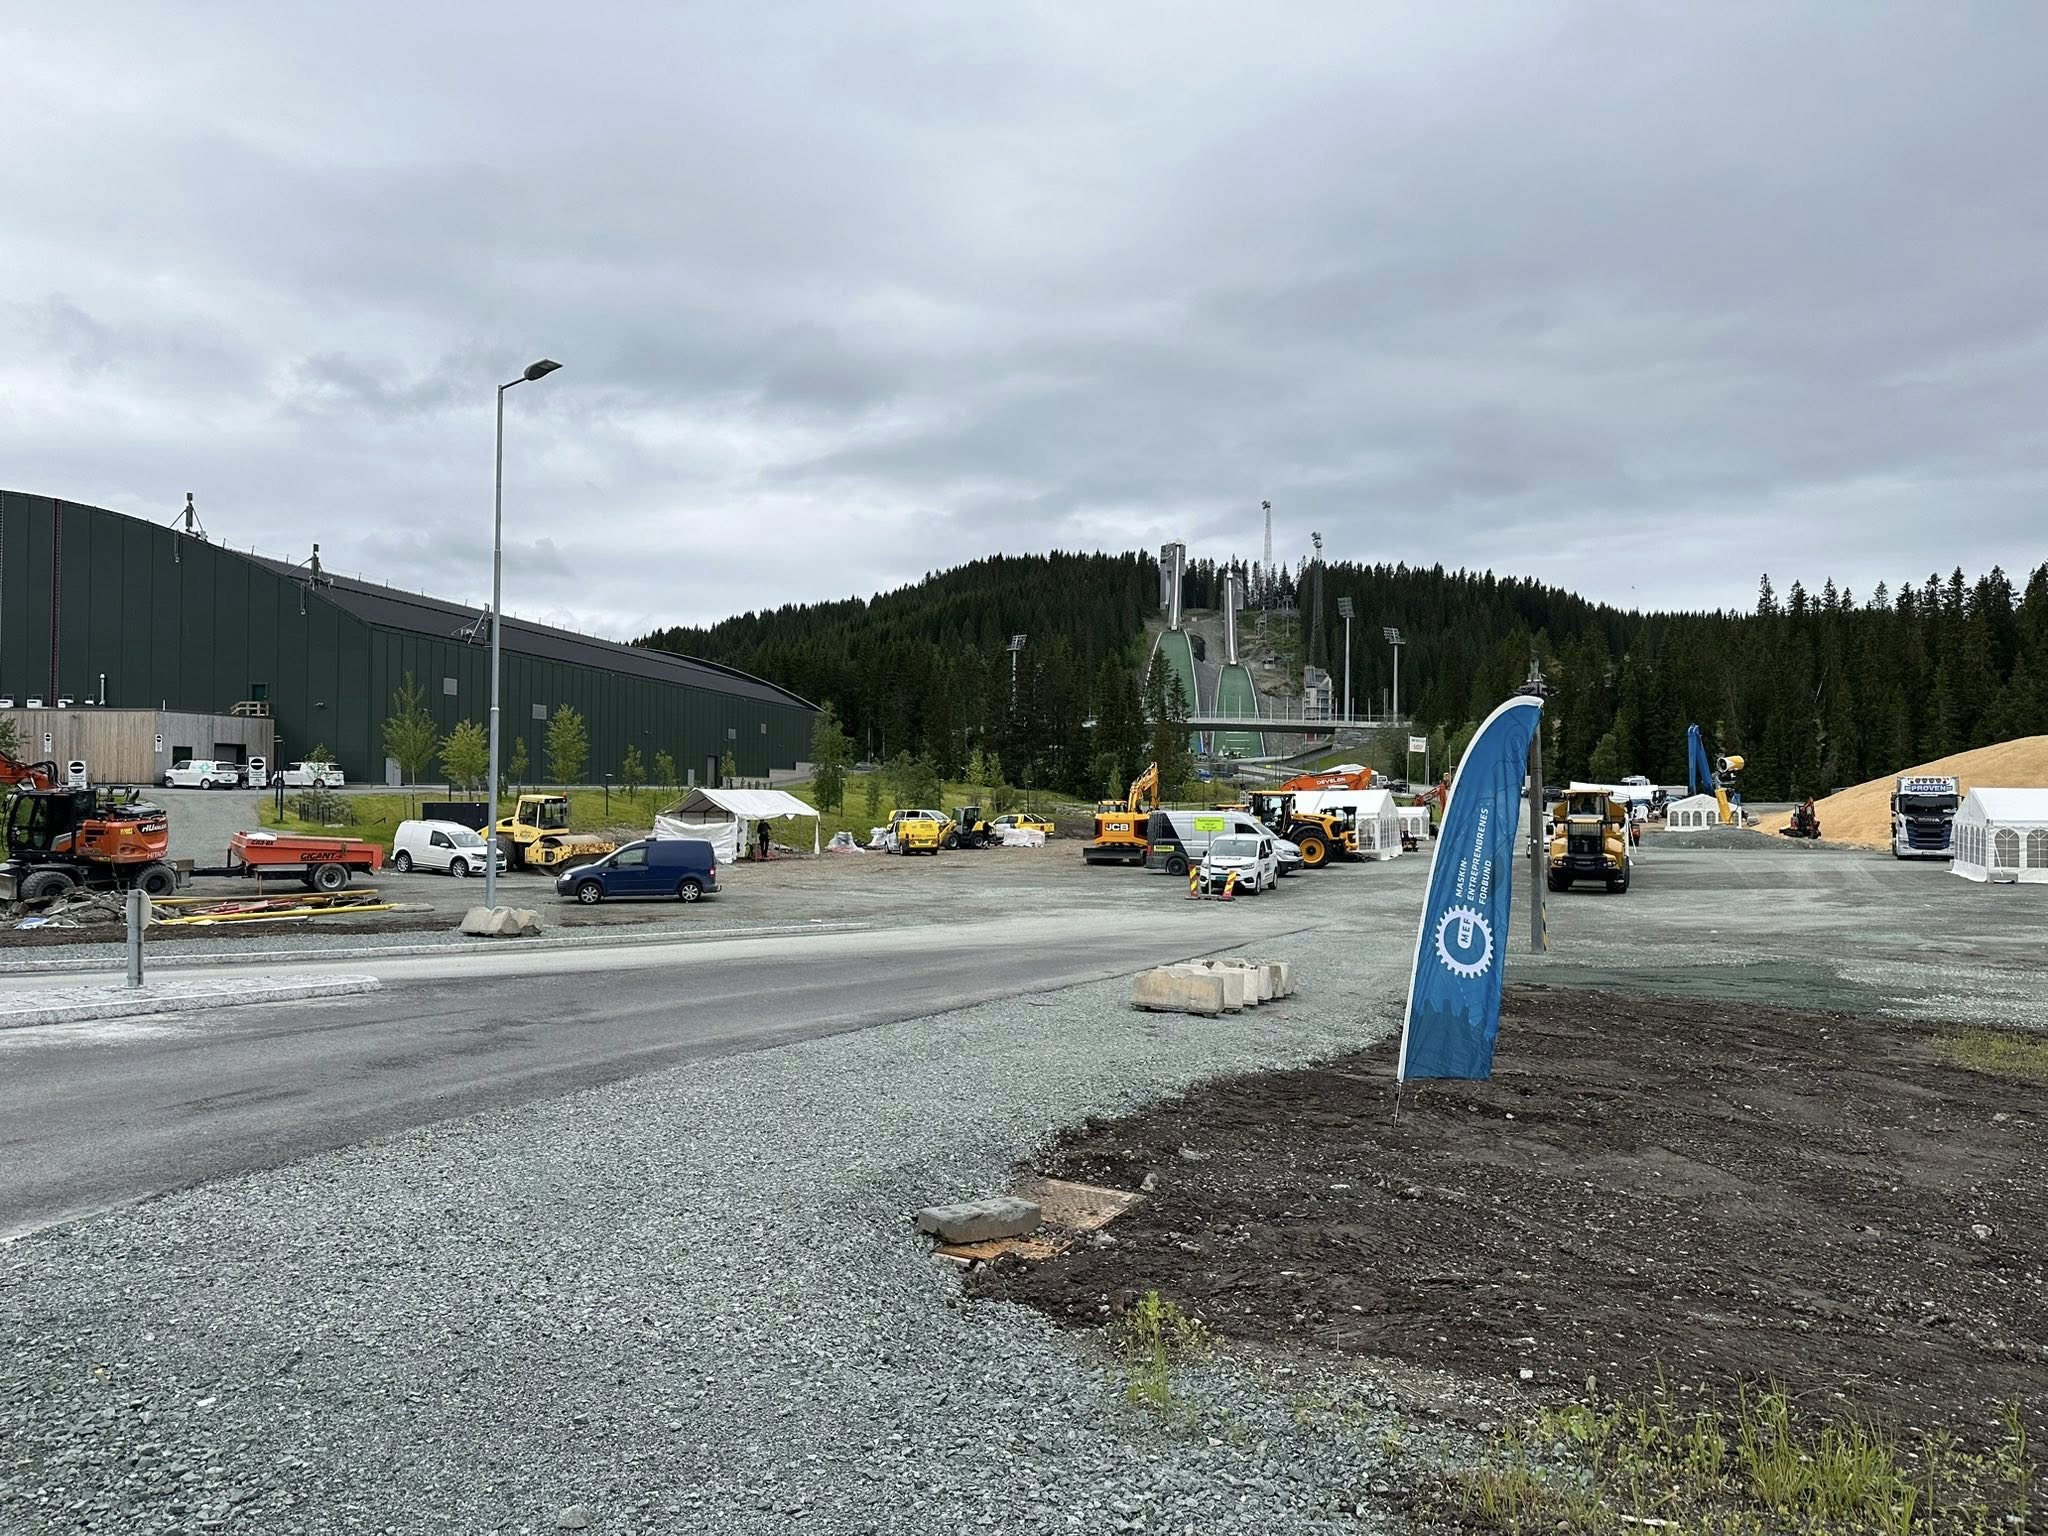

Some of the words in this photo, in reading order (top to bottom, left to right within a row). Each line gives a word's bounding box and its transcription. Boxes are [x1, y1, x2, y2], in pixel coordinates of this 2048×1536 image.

[1316, 777, 1346, 785] DEVELON
[1105, 823, 1129, 831] JCB
[301, 851, 337, 860] GIGANT
[1467, 807, 1489, 901] ENTREPRENØRENES
[1455, 856, 1468, 898] MASKIN-
[1479, 859, 1491, 905] FORBUND
[1460, 918, 1471, 943] MEF
